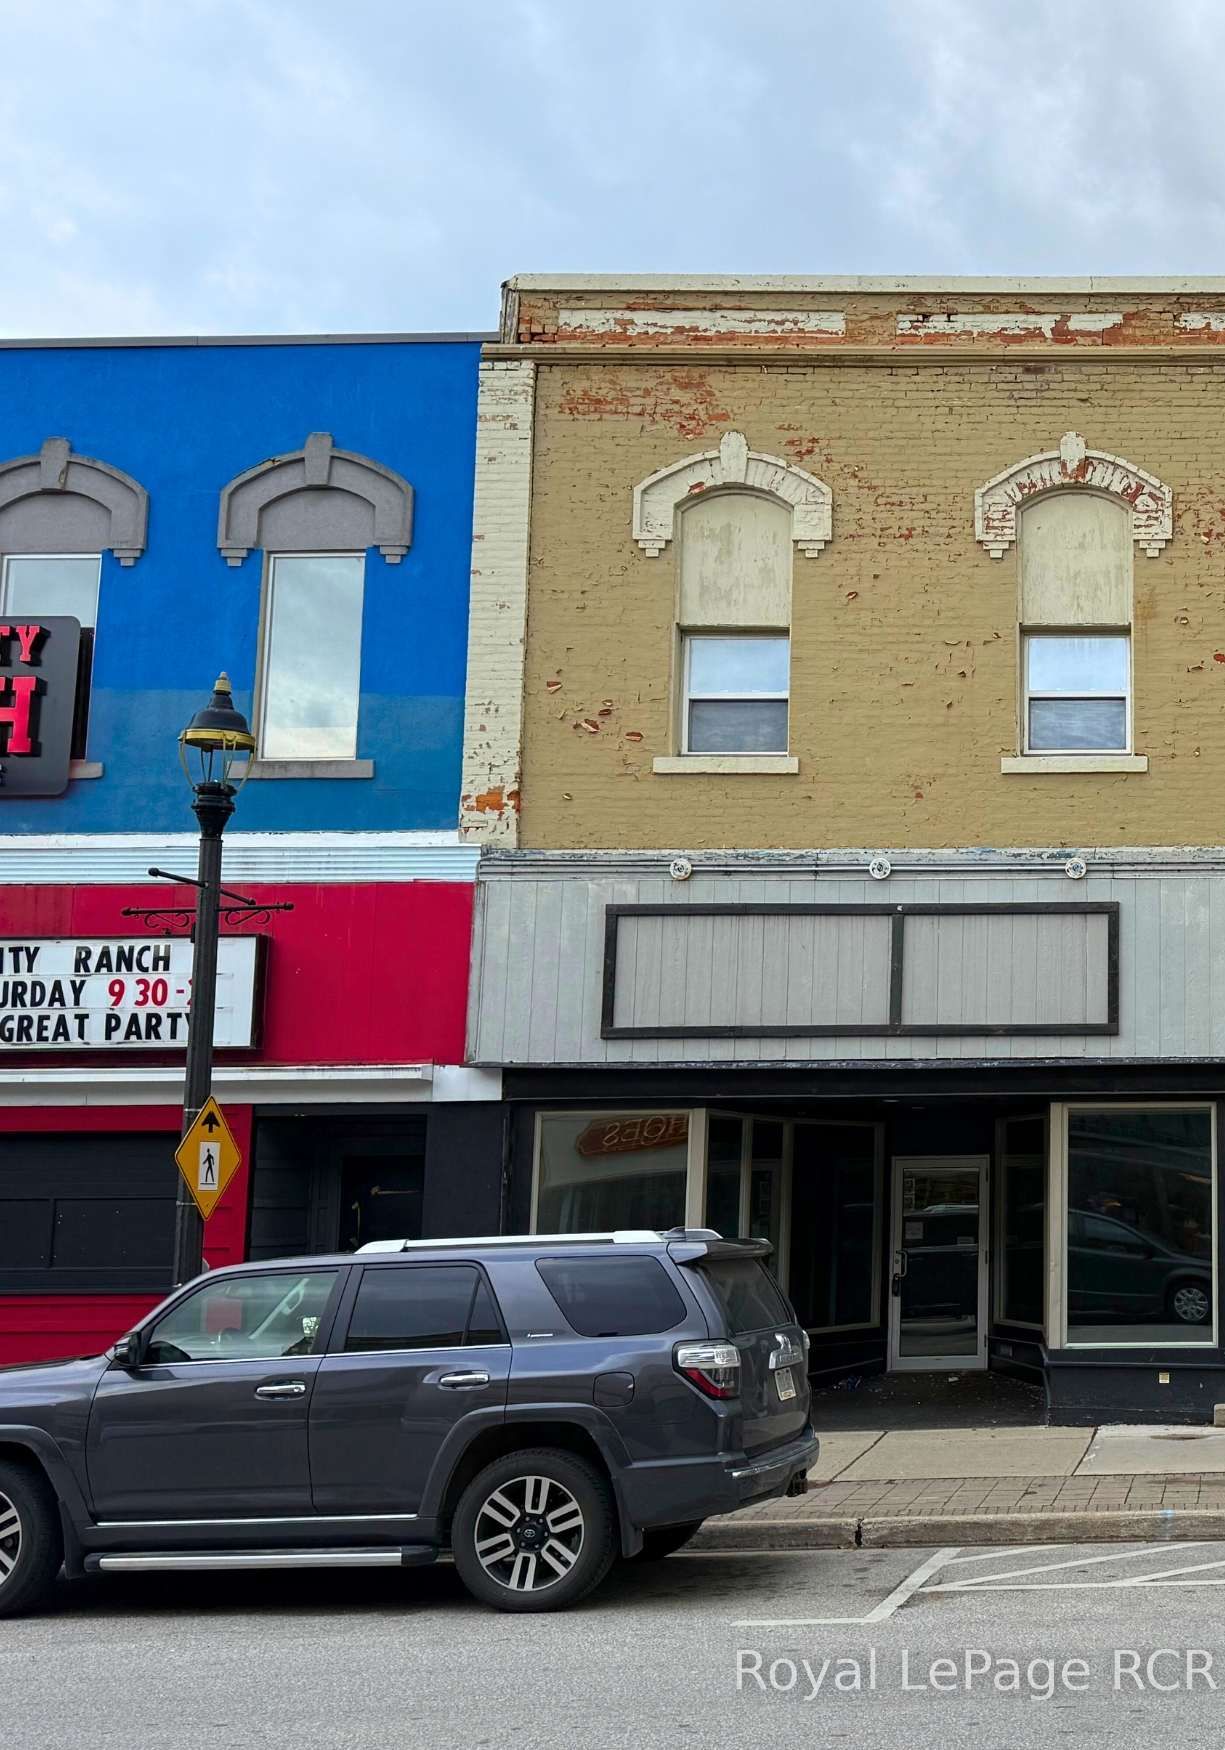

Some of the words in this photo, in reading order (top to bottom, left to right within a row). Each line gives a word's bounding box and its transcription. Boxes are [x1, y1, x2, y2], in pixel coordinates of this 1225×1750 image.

[73, 944, 172, 973] RANCH
[107, 978, 126, 1007] 9
[0, 1012, 90, 1042] GREAT
